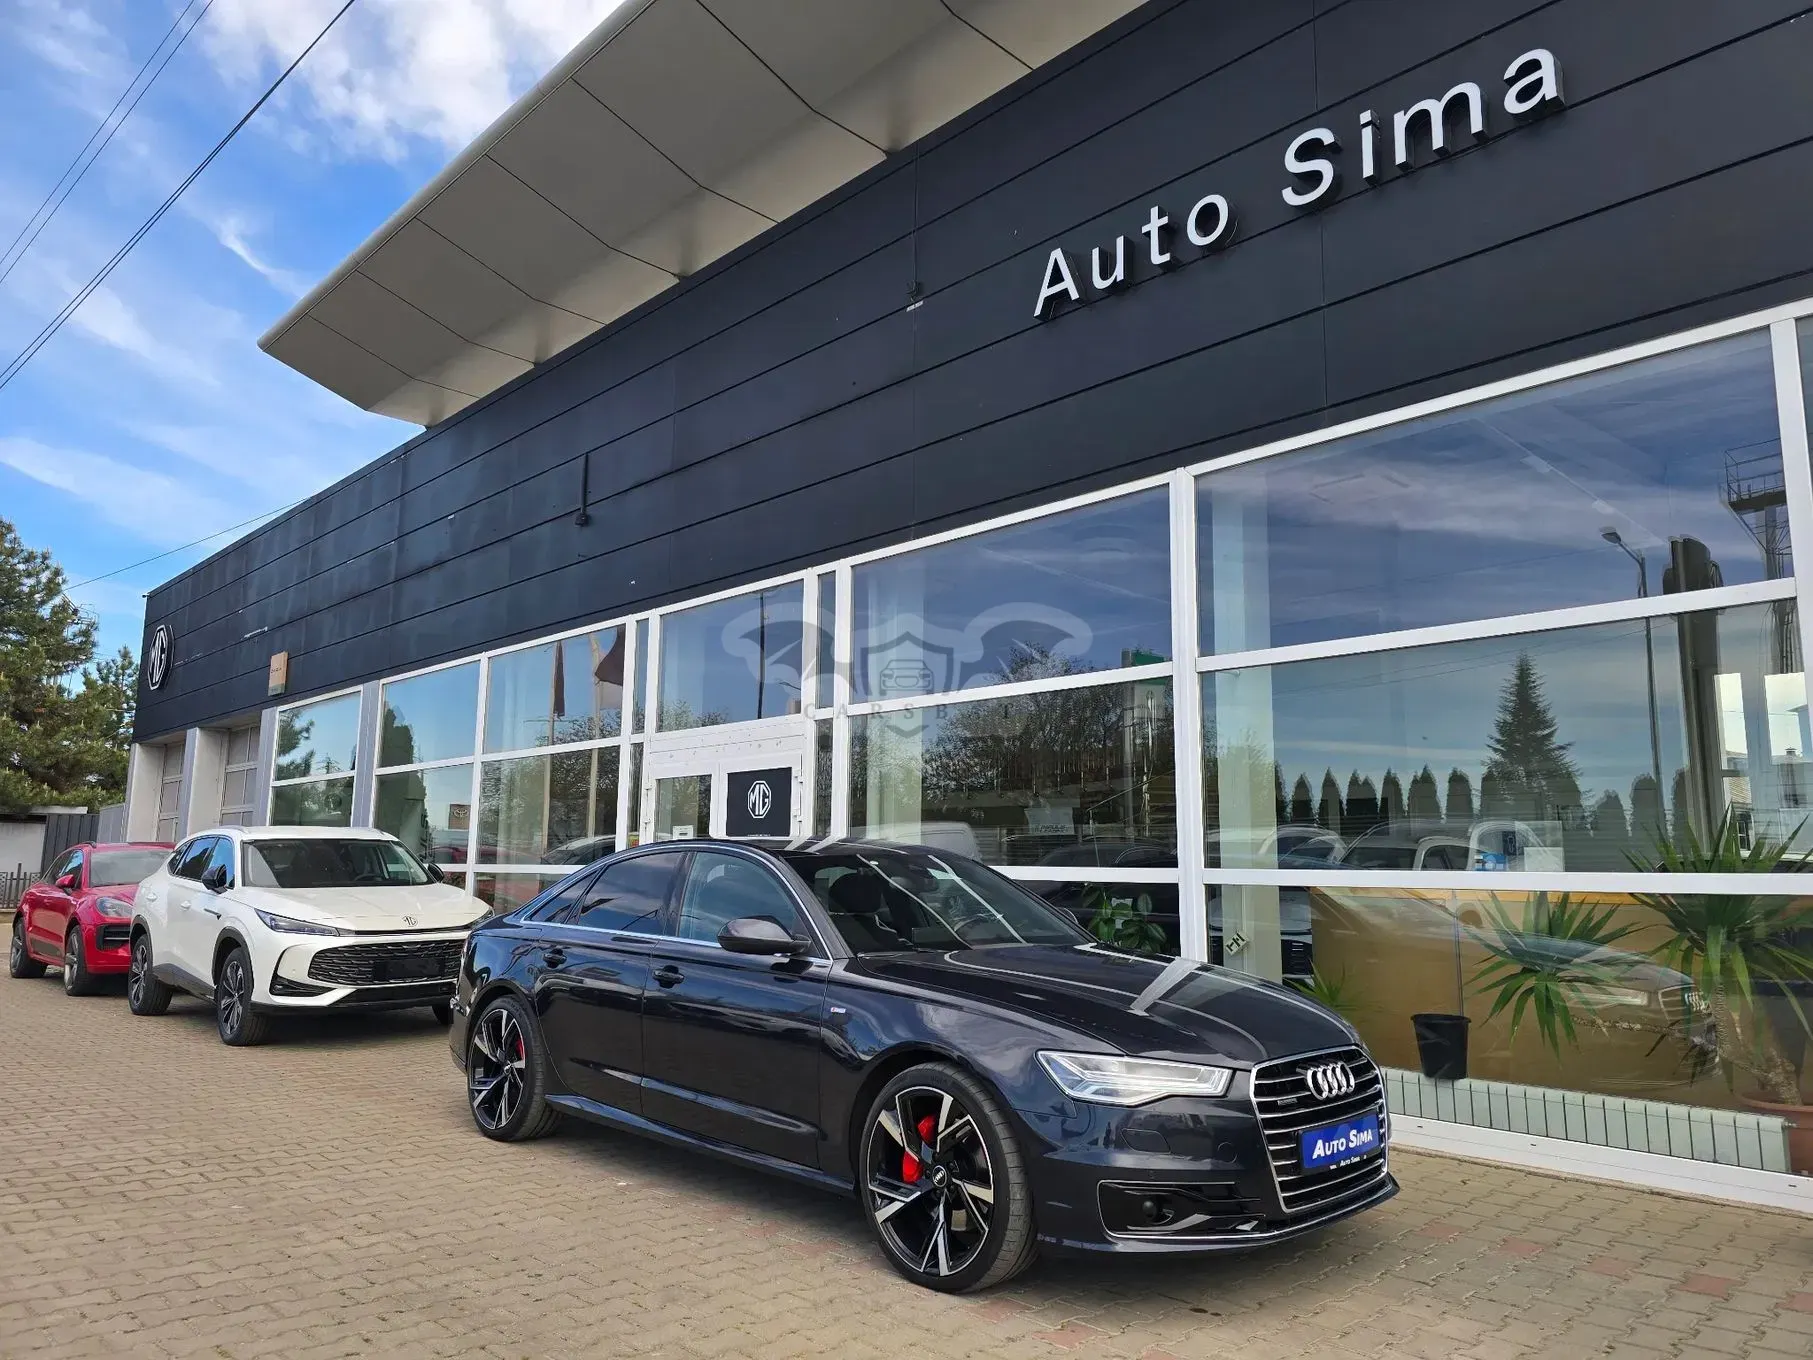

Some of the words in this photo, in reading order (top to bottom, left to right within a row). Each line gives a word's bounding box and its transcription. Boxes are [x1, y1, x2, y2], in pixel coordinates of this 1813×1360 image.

[1033, 194, 1231, 319] Auto
[1281, 48, 1562, 207] Sima
[149, 628, 167, 686] MG
[749, 783, 770, 816] MG
